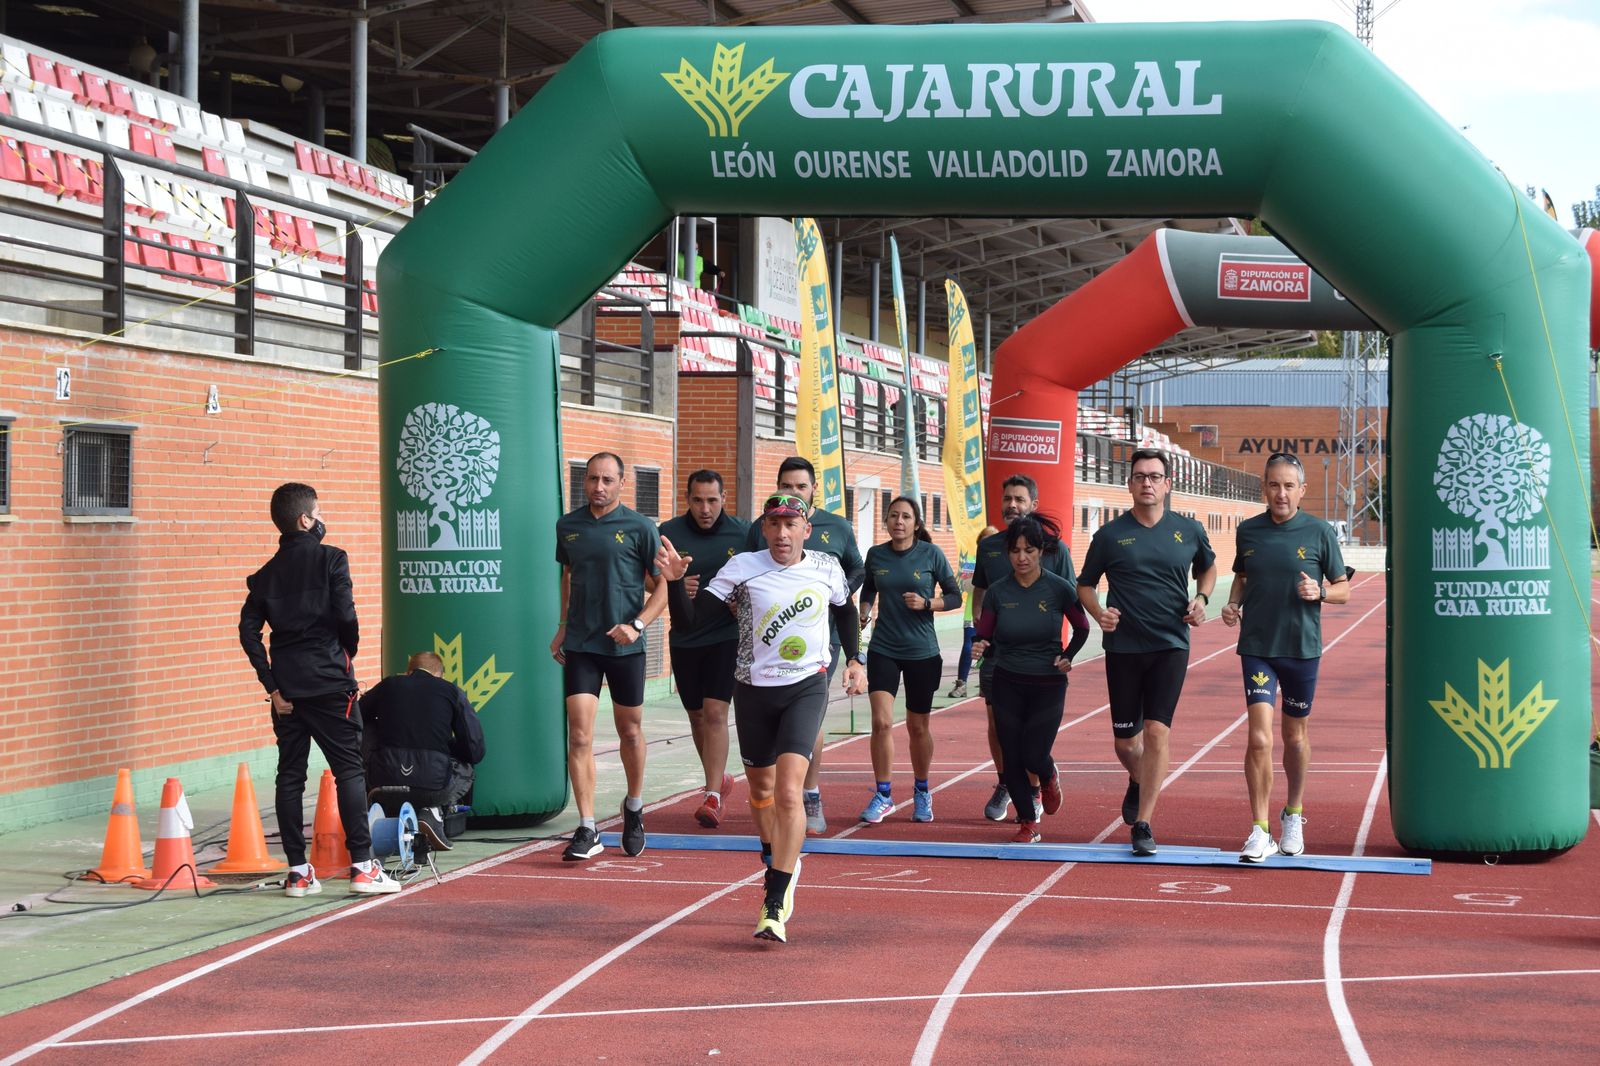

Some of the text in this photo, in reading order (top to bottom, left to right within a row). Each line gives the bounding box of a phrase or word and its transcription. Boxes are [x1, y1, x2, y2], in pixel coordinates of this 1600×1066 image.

[710, 142, 1223, 179] LEÓN OURENSE VALLADOLID ZAMORA
[1240, 270, 1291, 279] DIPUTACIÓN
[1240, 279, 1305, 293] ZAMORA
[56, 369, 71, 398] 12
[1001, 433, 1044, 443] DIPUTACIÓN
[1000, 441, 1056, 455] ZAMORA
[400, 560, 502, 576] FUNDACION
[399, 576, 504, 594] CAJA RURAL
[1434, 580, 1551, 598] FUNDACION
[1434, 598, 1552, 617] CAJA RURAL
[761, 596, 813, 646] POR HUGO
